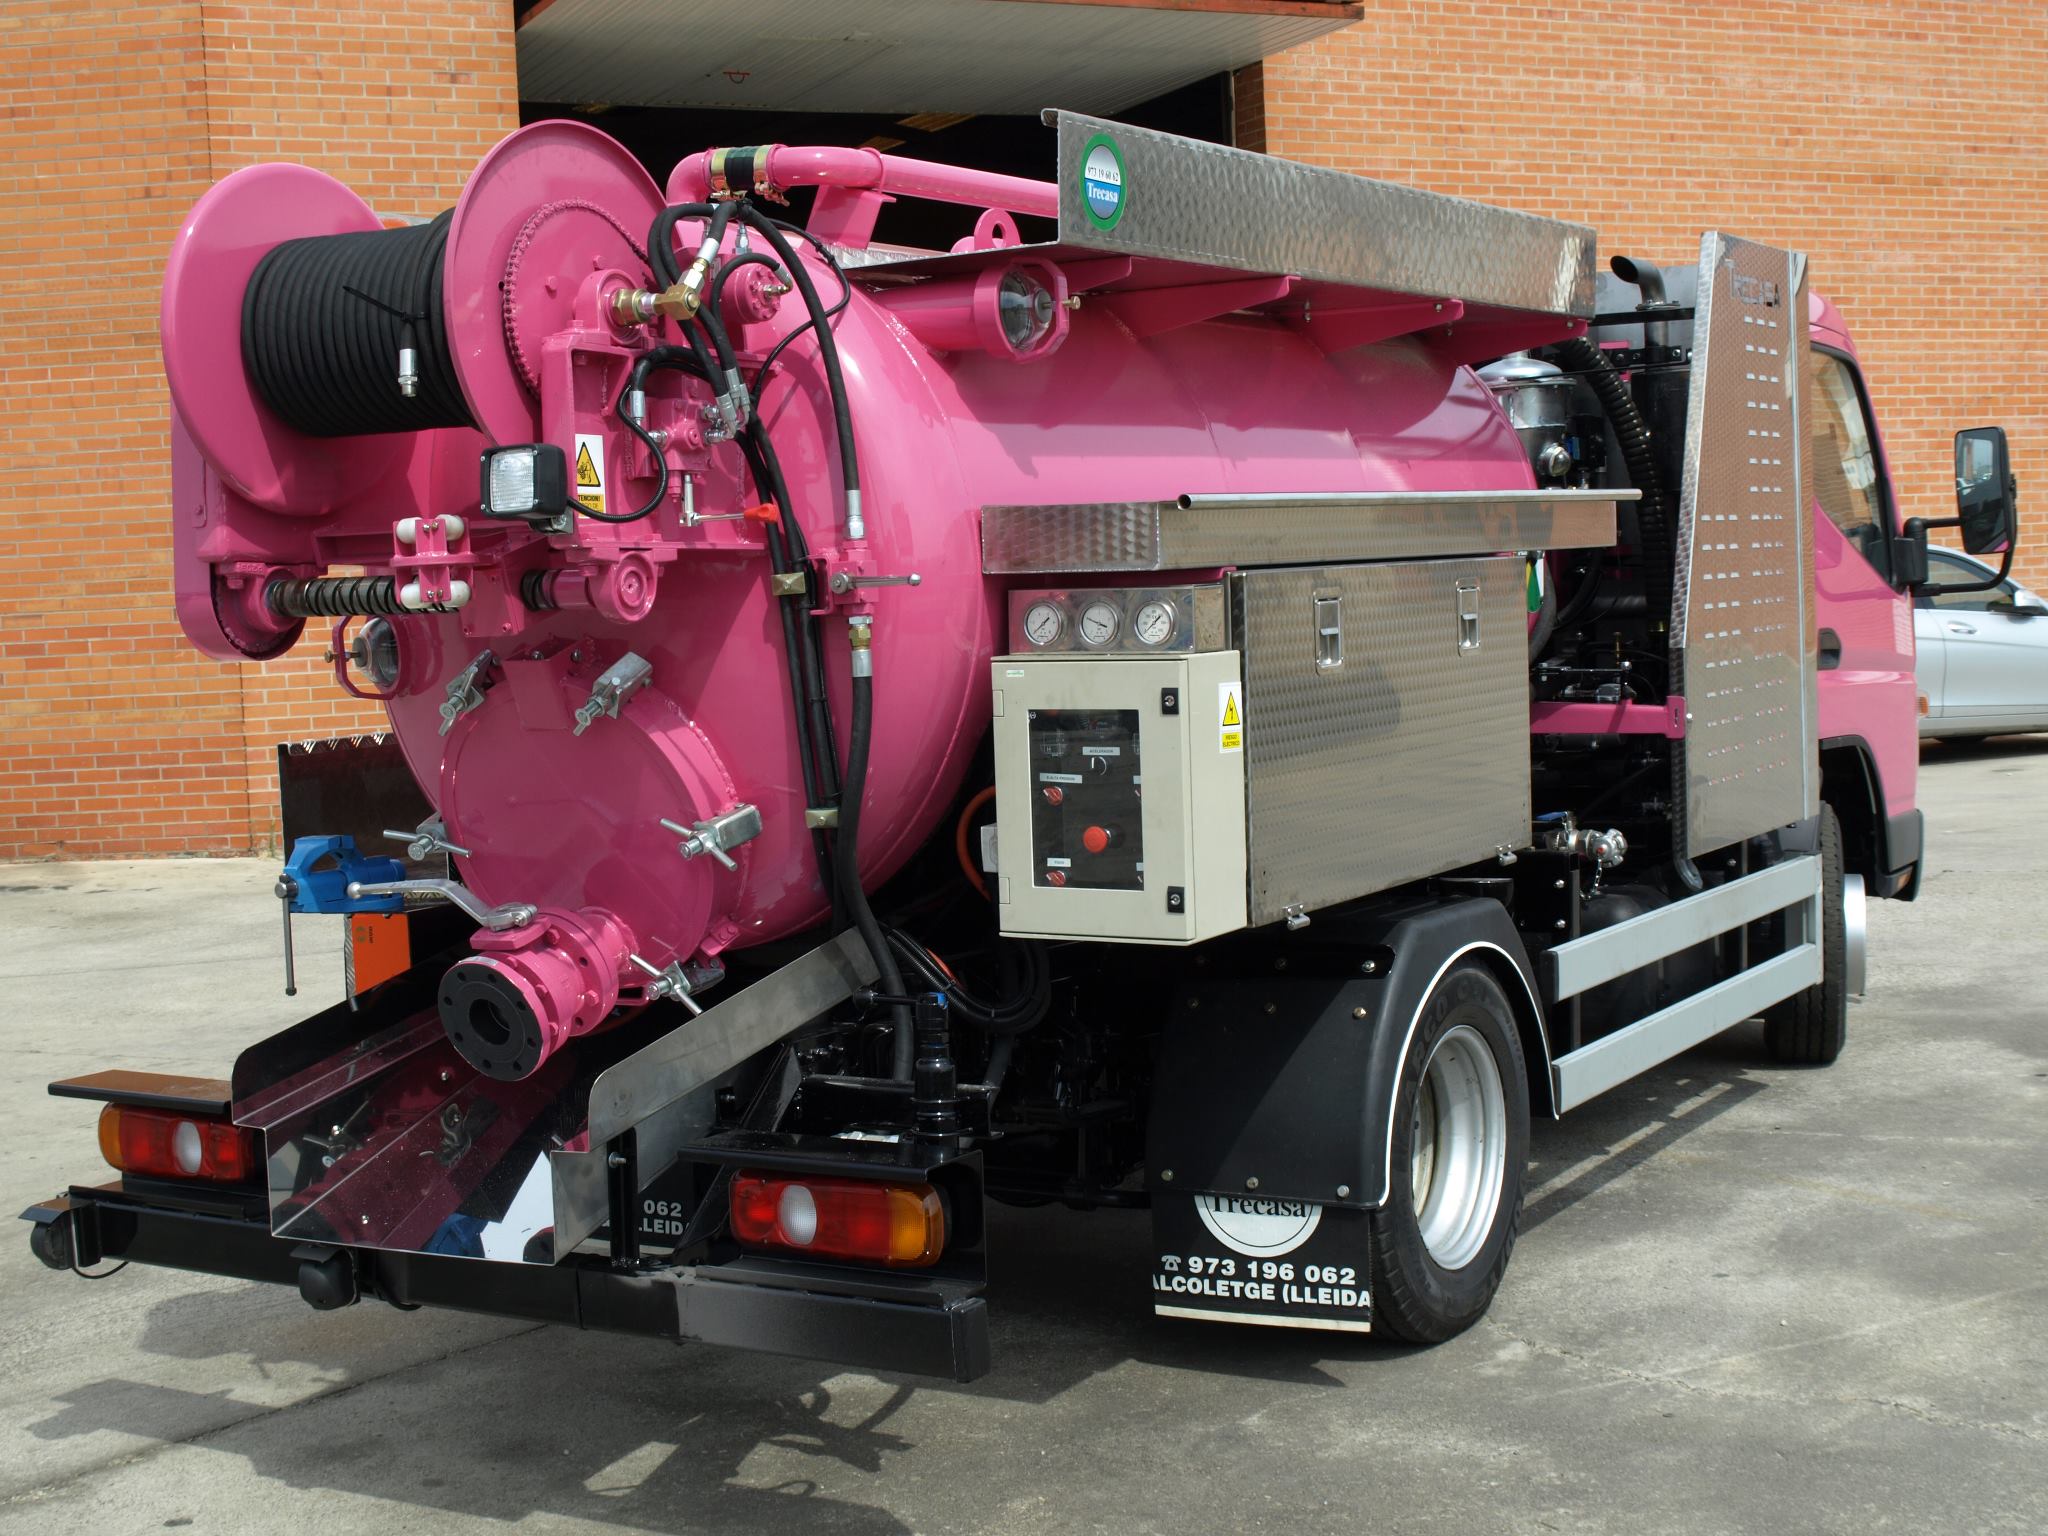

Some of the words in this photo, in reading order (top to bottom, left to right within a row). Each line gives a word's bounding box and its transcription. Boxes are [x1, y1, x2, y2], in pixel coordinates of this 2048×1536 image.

[1087, 166, 1097, 177] 973
[1098, 168, 1105, 178] 19
[1105, 170, 1112, 180] 60
[1112, 172, 1119, 182] 62
[1087, 182, 1119, 203] Trecasa
[643, 1199, 682, 1218] 062
[1213, 1196, 1307, 1218] Trecasa
[638, 1217, 689, 1236] LEID
[1188, 1256, 1236, 1276] 973
[1247, 1260, 1295, 1281] 196
[1304, 1265, 1356, 1286] 062
